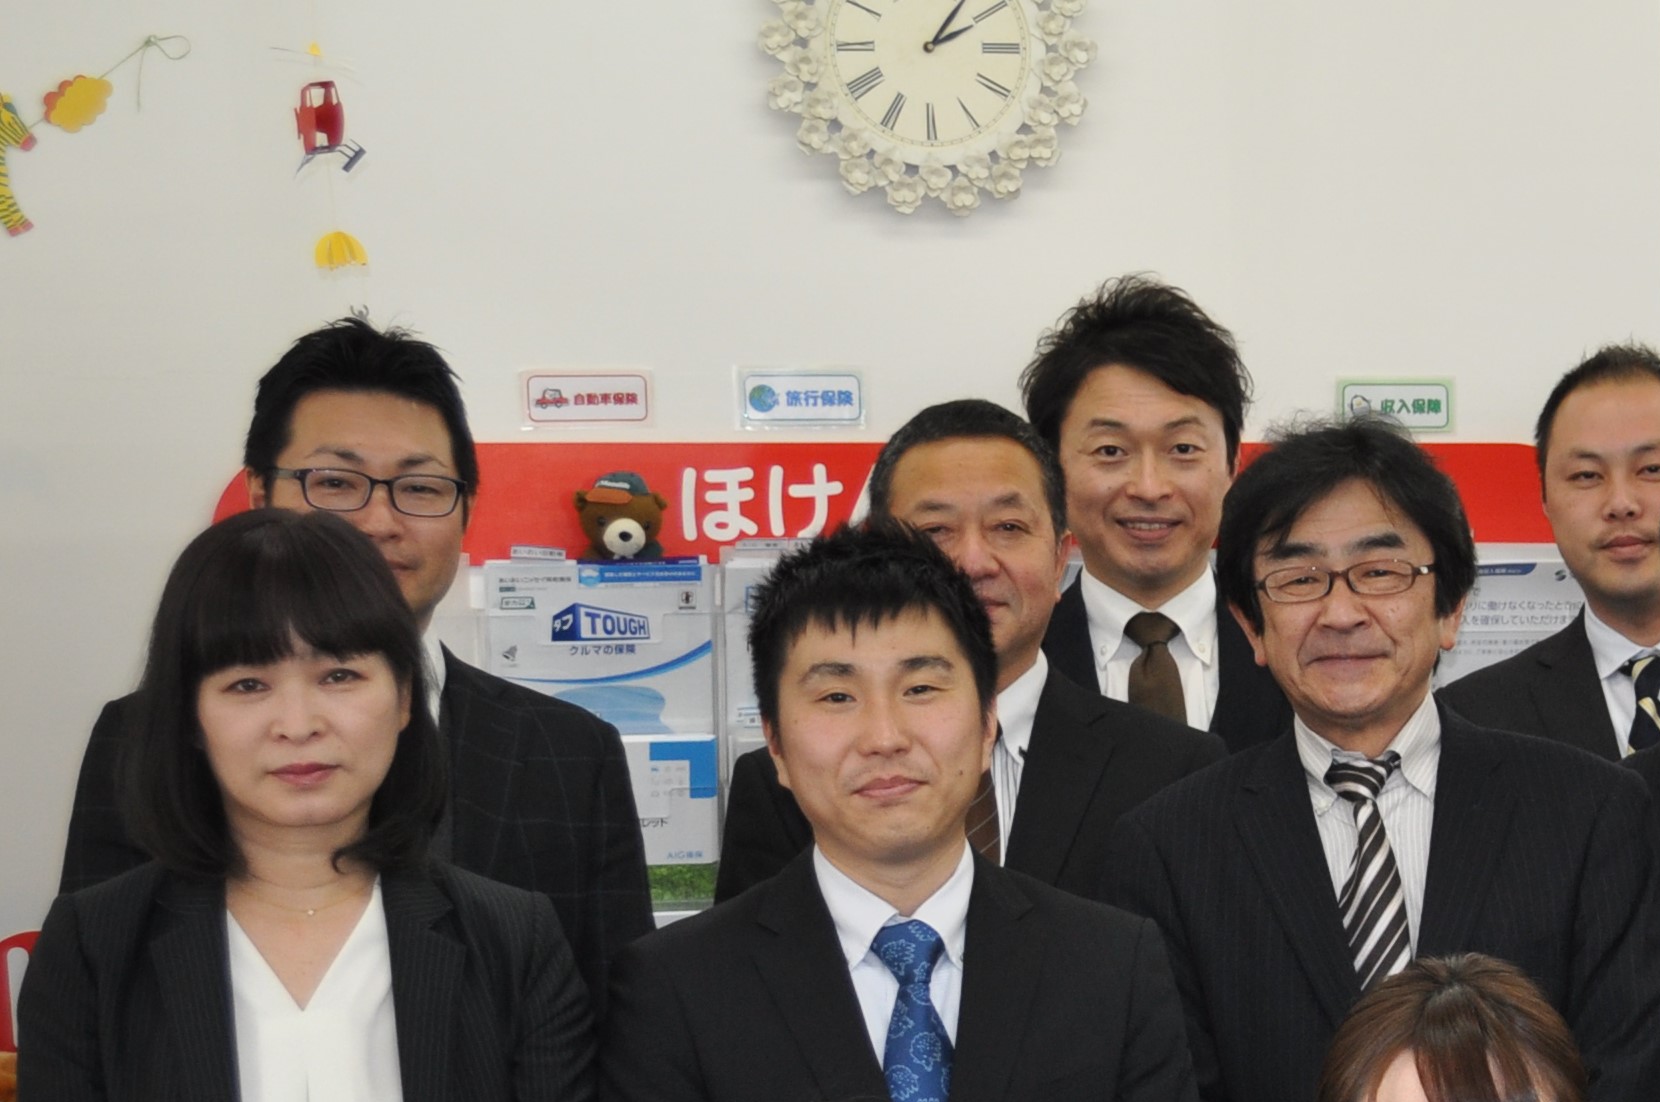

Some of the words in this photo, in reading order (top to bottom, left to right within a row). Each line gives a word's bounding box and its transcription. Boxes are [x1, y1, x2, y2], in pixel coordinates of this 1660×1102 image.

[573, 391, 639, 406] 自動車保険
[785, 389, 854, 407] 旅行保険
[682, 463, 877, 541] ほけ
[553, 612, 574, 633] タフ
[584, 611, 647, 636] TOUGH
[569, 644, 636, 656] クルマの保険
